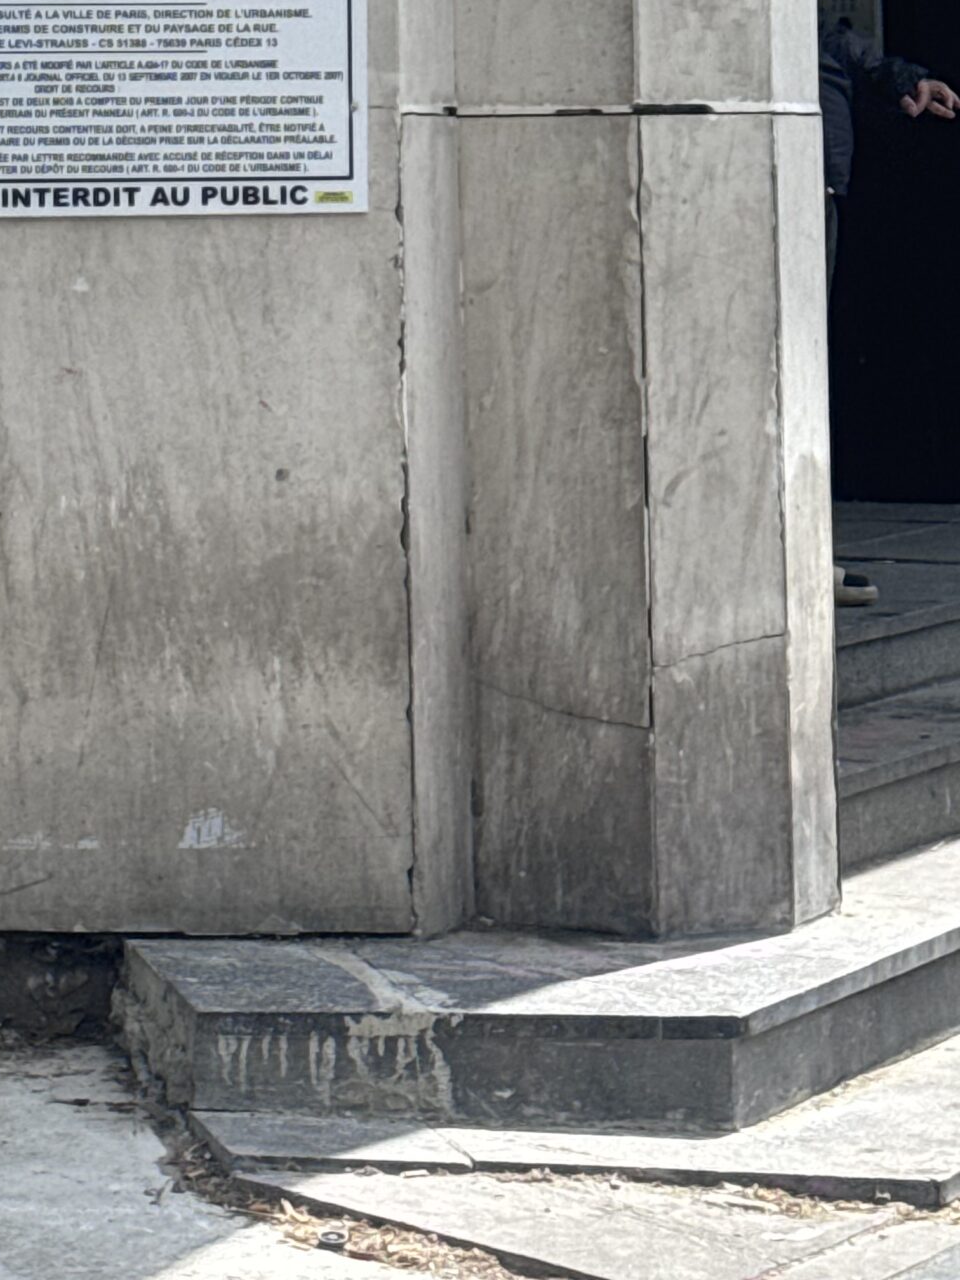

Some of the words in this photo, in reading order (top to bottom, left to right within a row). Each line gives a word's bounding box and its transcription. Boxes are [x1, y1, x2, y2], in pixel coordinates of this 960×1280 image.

[1, 188, 140, 207] INTERDIT
[150, 187, 190, 206] AU
[201, 186, 308, 205] PUBLIC
